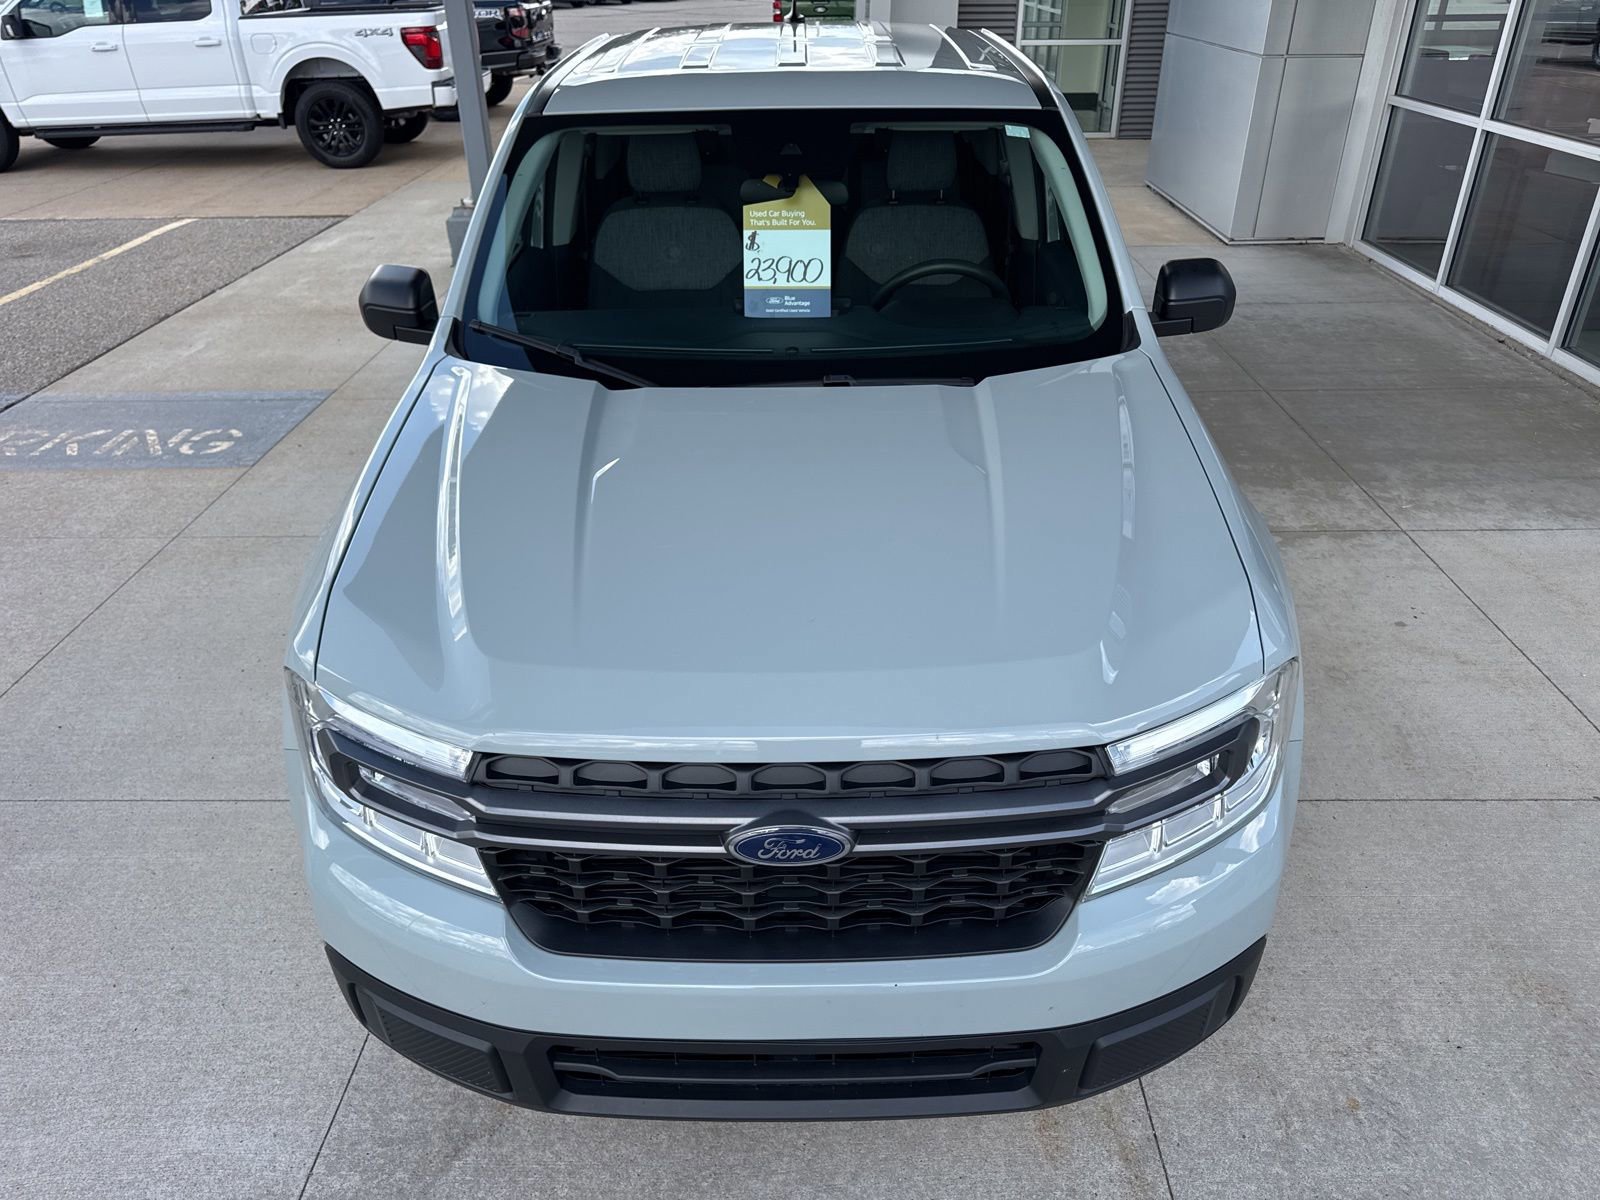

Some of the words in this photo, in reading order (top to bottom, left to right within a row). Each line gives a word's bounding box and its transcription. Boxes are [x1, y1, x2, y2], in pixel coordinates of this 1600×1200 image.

[781, 210, 805, 218] Buying
[745, 230, 760, 252] $
[745, 255, 824, 285] 23,900
[757, 837, 822, 859] Ford
